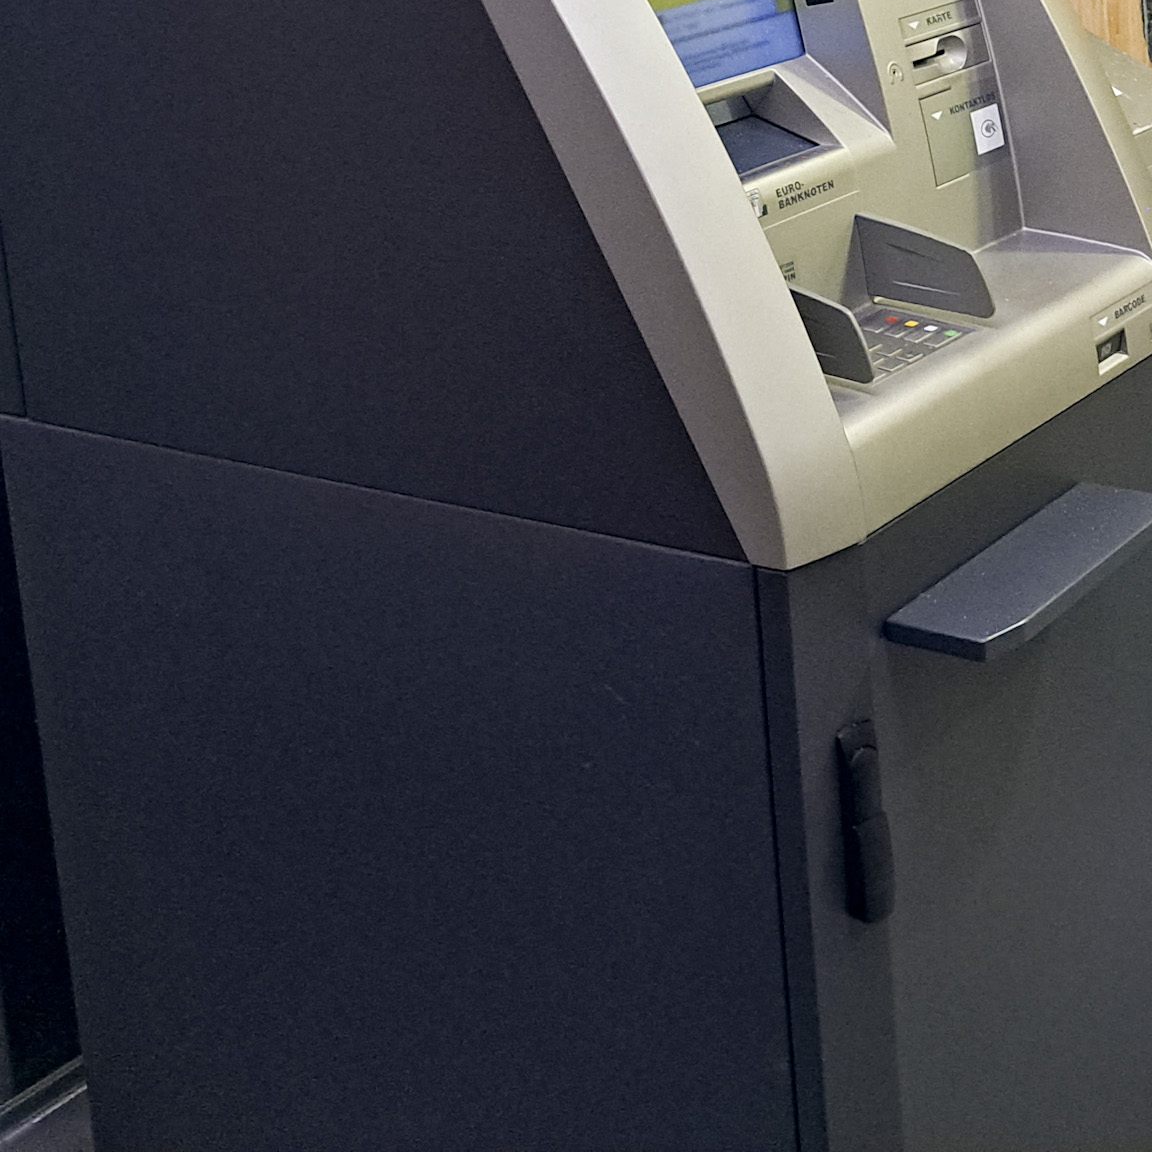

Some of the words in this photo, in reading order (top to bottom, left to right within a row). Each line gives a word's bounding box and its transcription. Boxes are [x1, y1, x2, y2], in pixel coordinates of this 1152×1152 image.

[926, 11, 952, 25] KARTE
[775, 181, 804, 197] EURO-
[778, 180, 834, 209] BANKNOTEN
[1115, 294, 1145, 318] BARCODE
